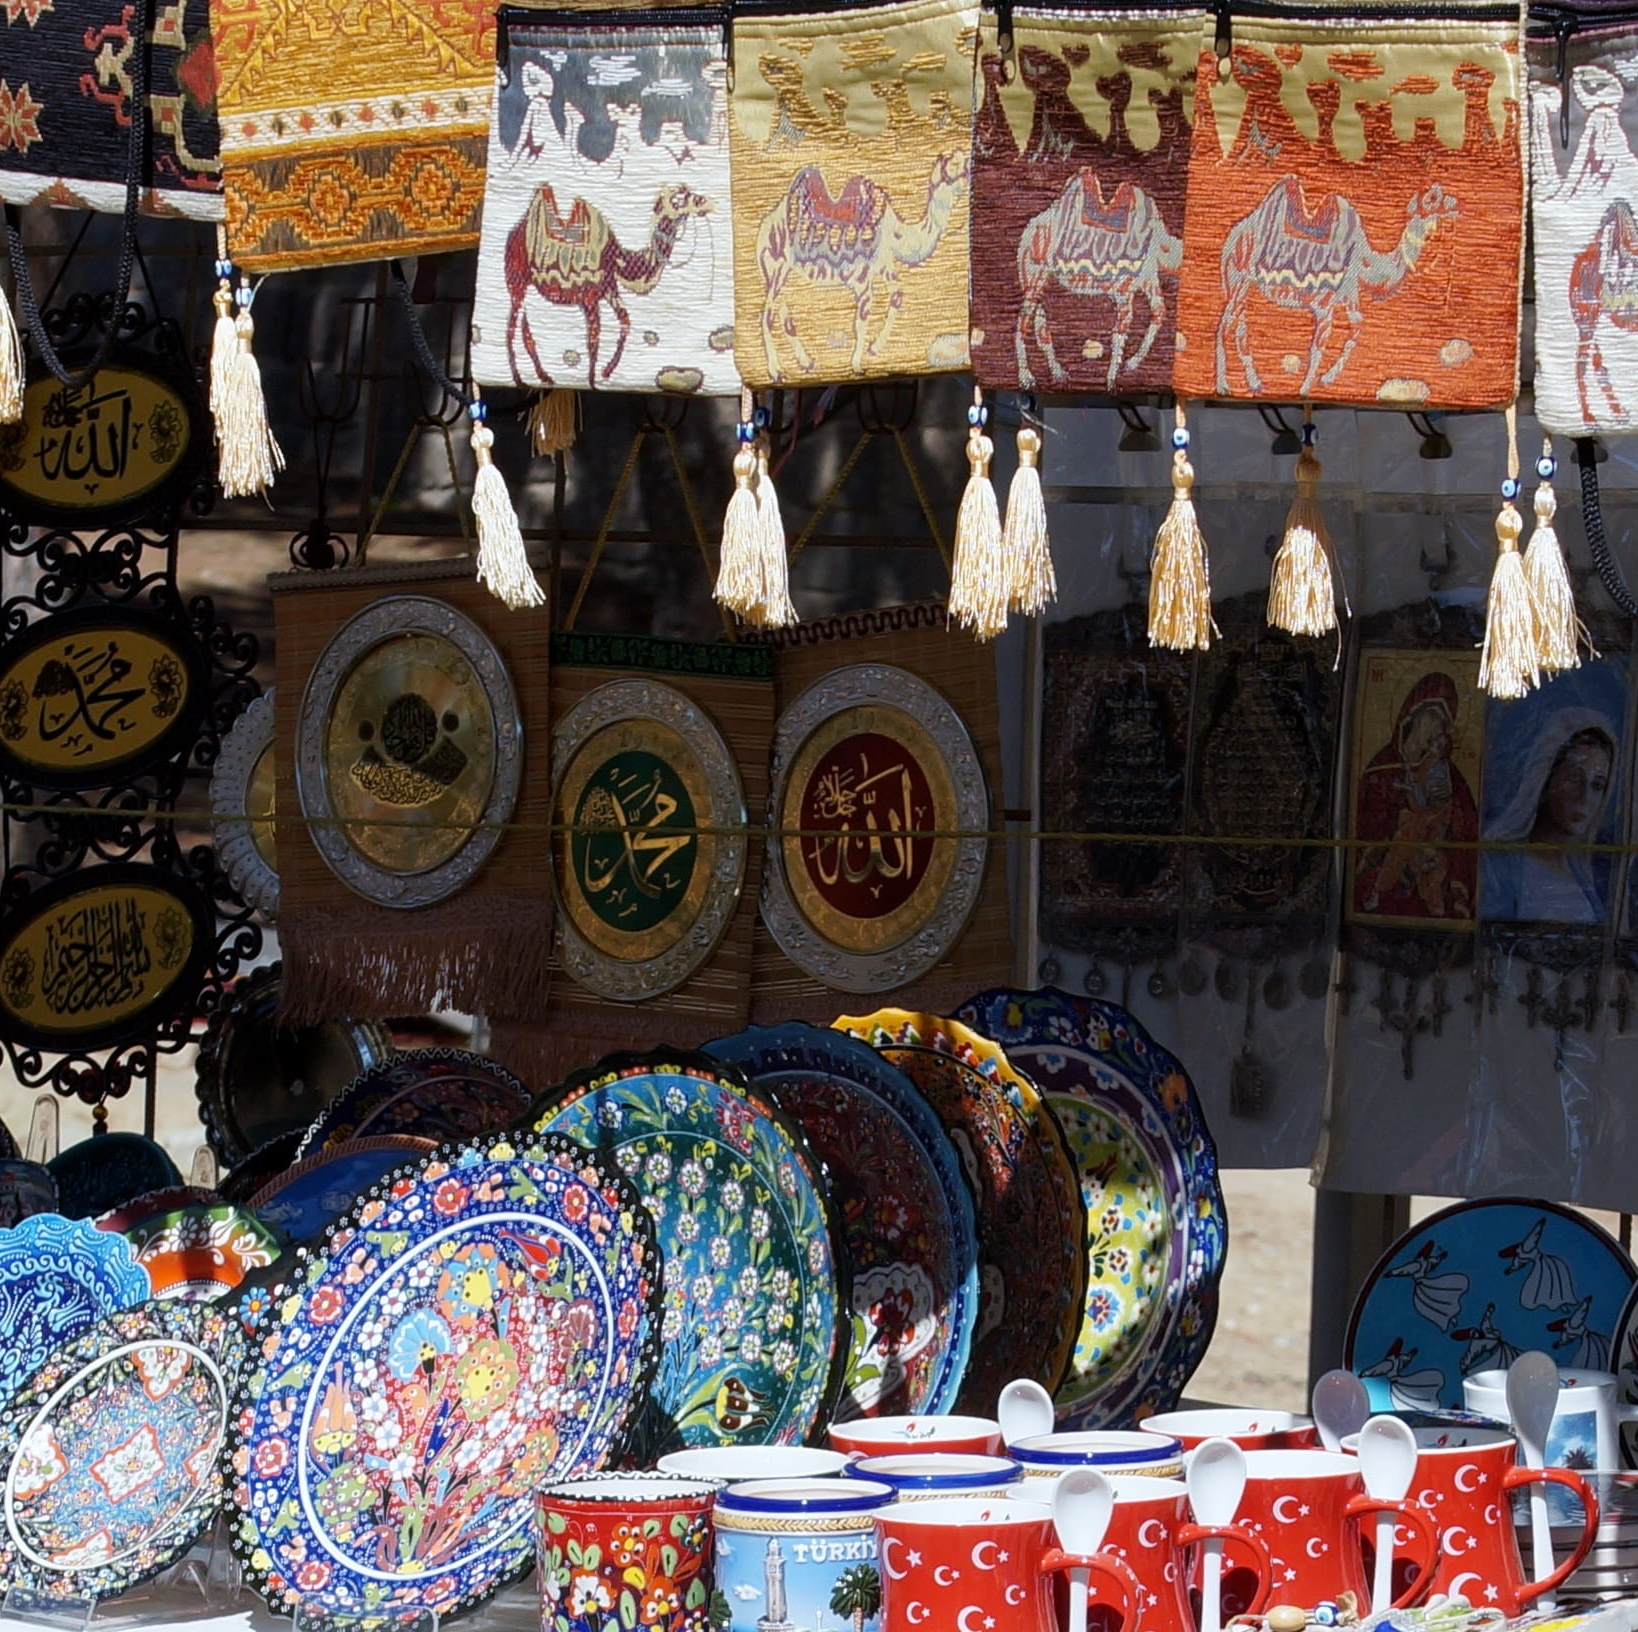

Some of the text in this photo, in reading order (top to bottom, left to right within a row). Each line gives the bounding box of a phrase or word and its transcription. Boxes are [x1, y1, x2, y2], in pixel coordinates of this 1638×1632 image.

[34, 384, 137, 490] الله
[34, 645, 145, 750] محمد
[582, 772, 691, 908] محمد
[808, 755, 919, 890] الله
